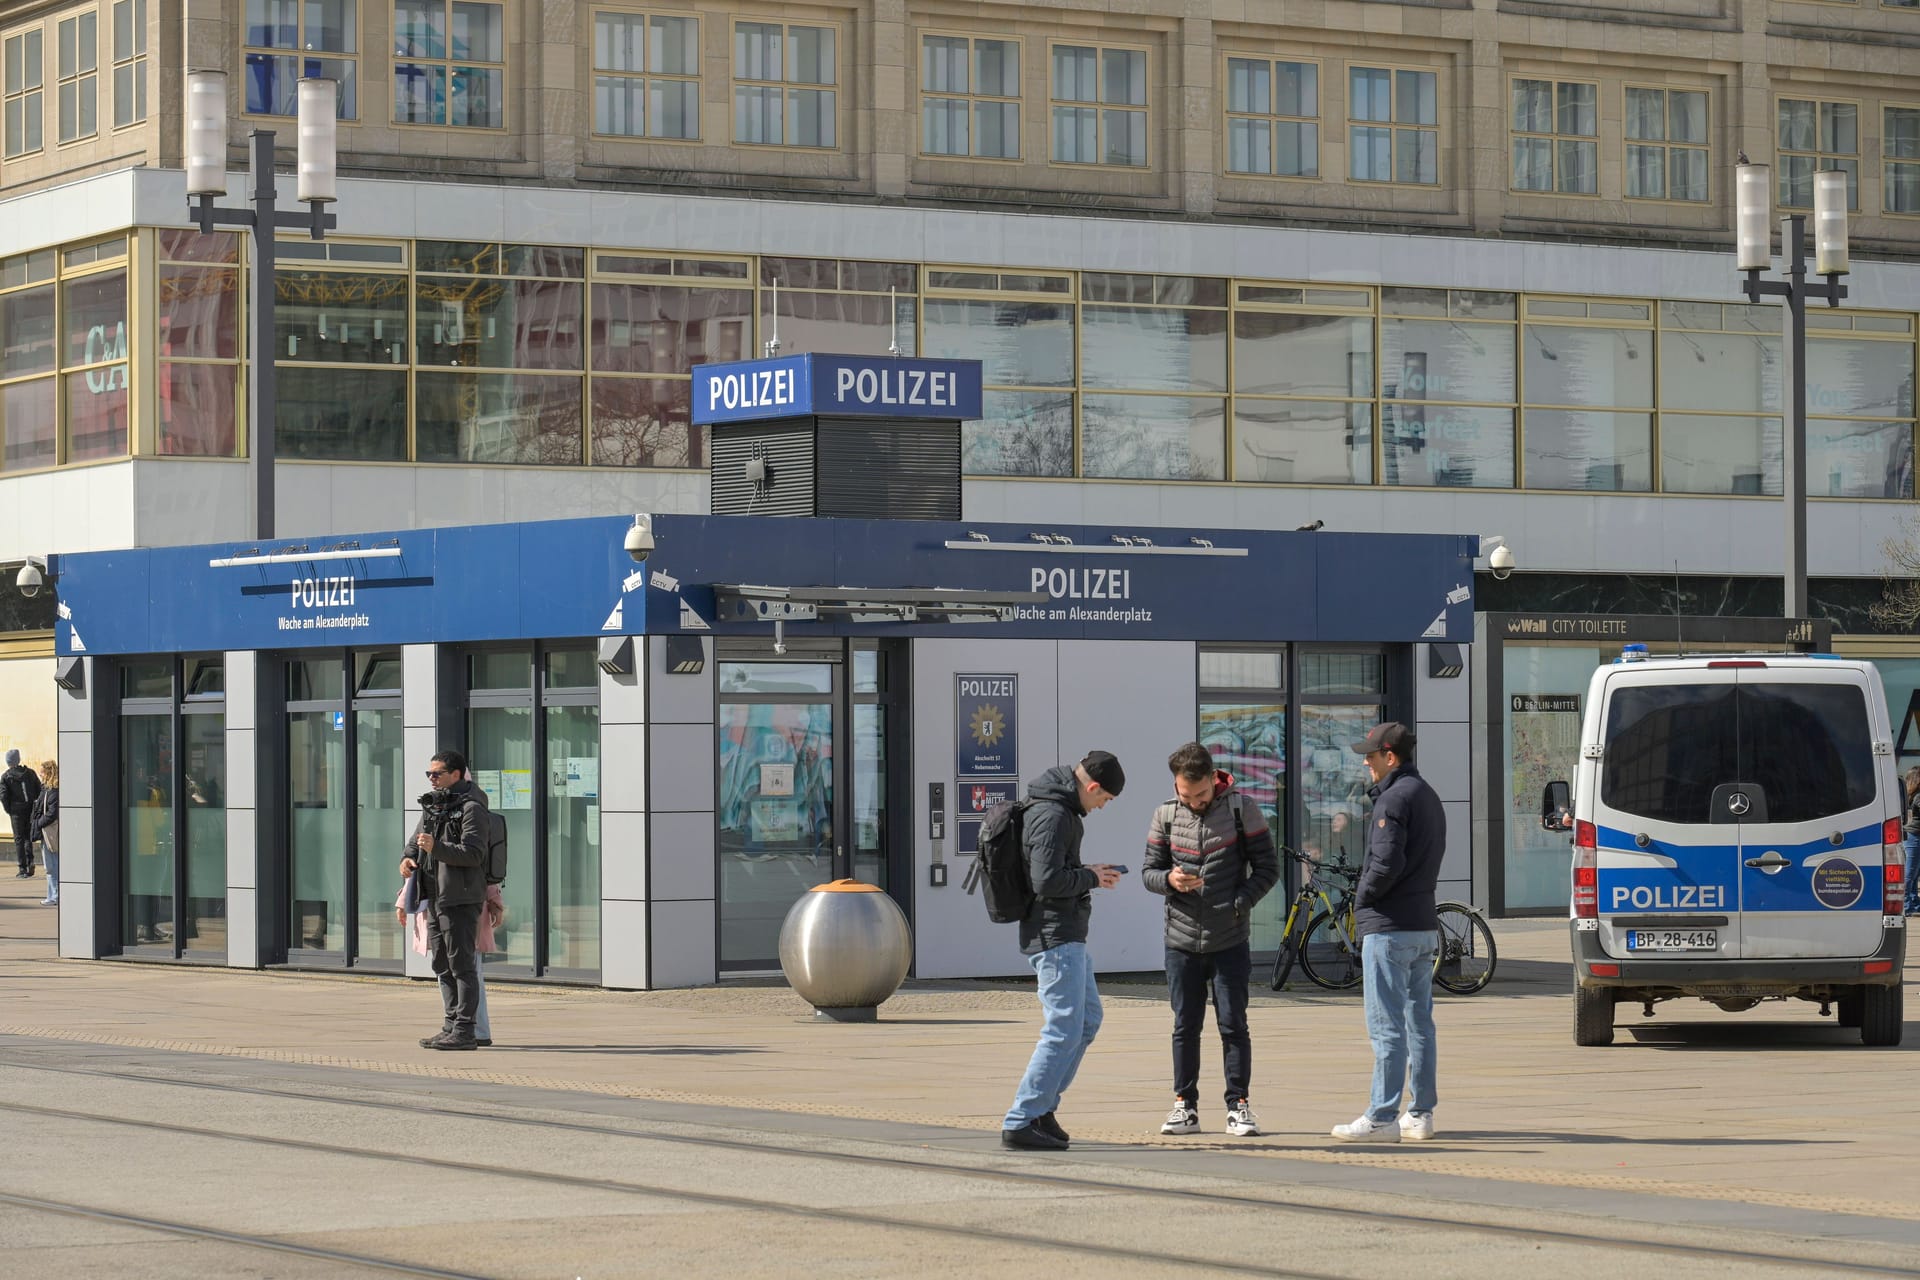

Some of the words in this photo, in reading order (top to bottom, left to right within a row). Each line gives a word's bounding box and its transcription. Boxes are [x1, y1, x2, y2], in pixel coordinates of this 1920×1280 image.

[85, 320, 128, 394] C&A
[709, 368, 795, 411] POLIZEI
[836, 368, 957, 406] POLIZEI
[291, 576, 354, 608] POLIZEI
[652, 579, 667, 588] CCTV
[1031, 567, 1130, 599] POLIZEI
[278, 615, 302, 630] Wache
[303, 618, 314, 629] am
[315, 612, 370, 630] Alexanderplatz
[1049, 608, 1066, 621] am
[1069, 606, 1152, 624] Alexanderplatz
[1520, 618, 1547, 633] Wall
[1552, 619, 1577, 634] CITY
[1578, 619, 1627, 634] TOILETTE
[961, 680, 1013, 697] POLIZEI
[1612, 885, 1724, 909] POLIZEI
[1636, 932, 1656, 947] BP
[1663, 932, 1715, 947] 28-416
